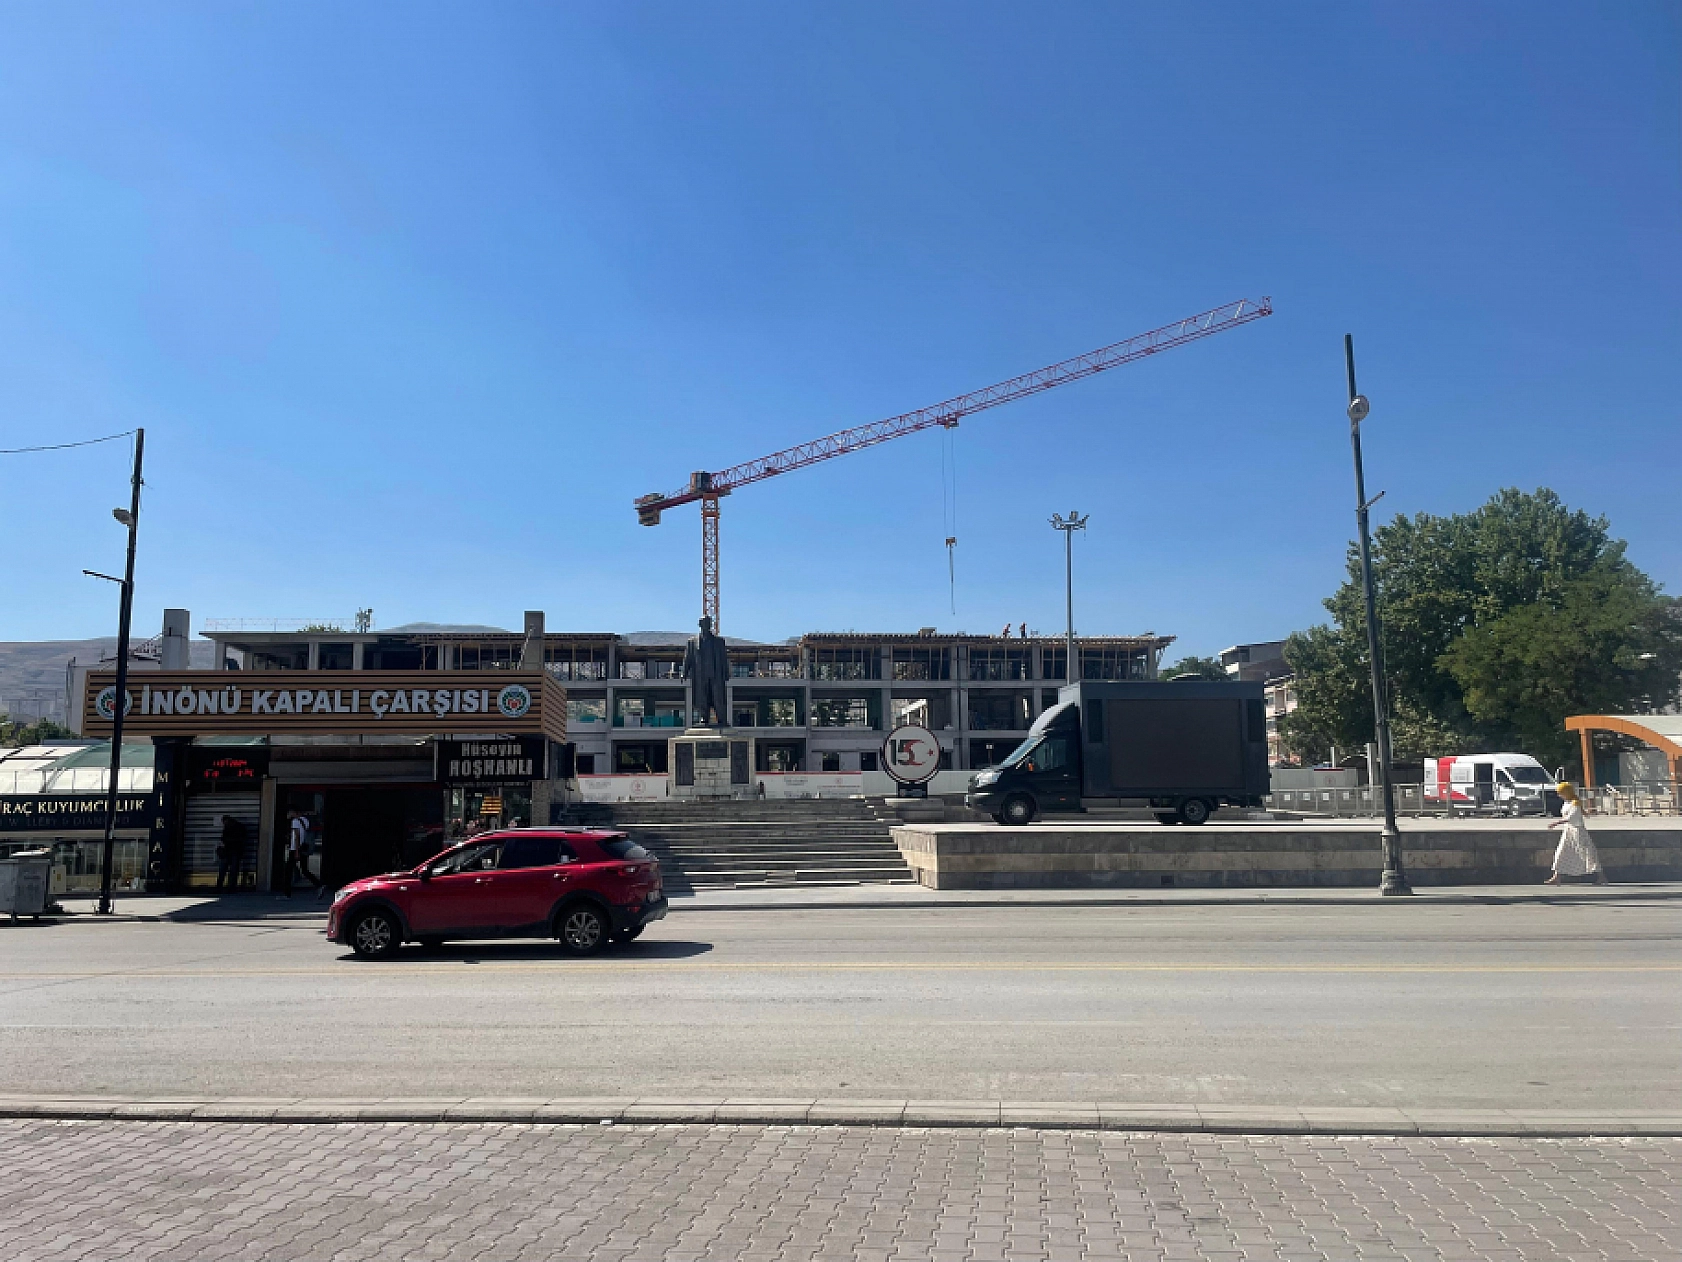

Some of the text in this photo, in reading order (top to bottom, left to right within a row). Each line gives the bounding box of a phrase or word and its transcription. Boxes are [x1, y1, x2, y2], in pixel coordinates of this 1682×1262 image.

[139, 684, 489, 719] İNÖNÜ KAPALI ÇARŞISI
